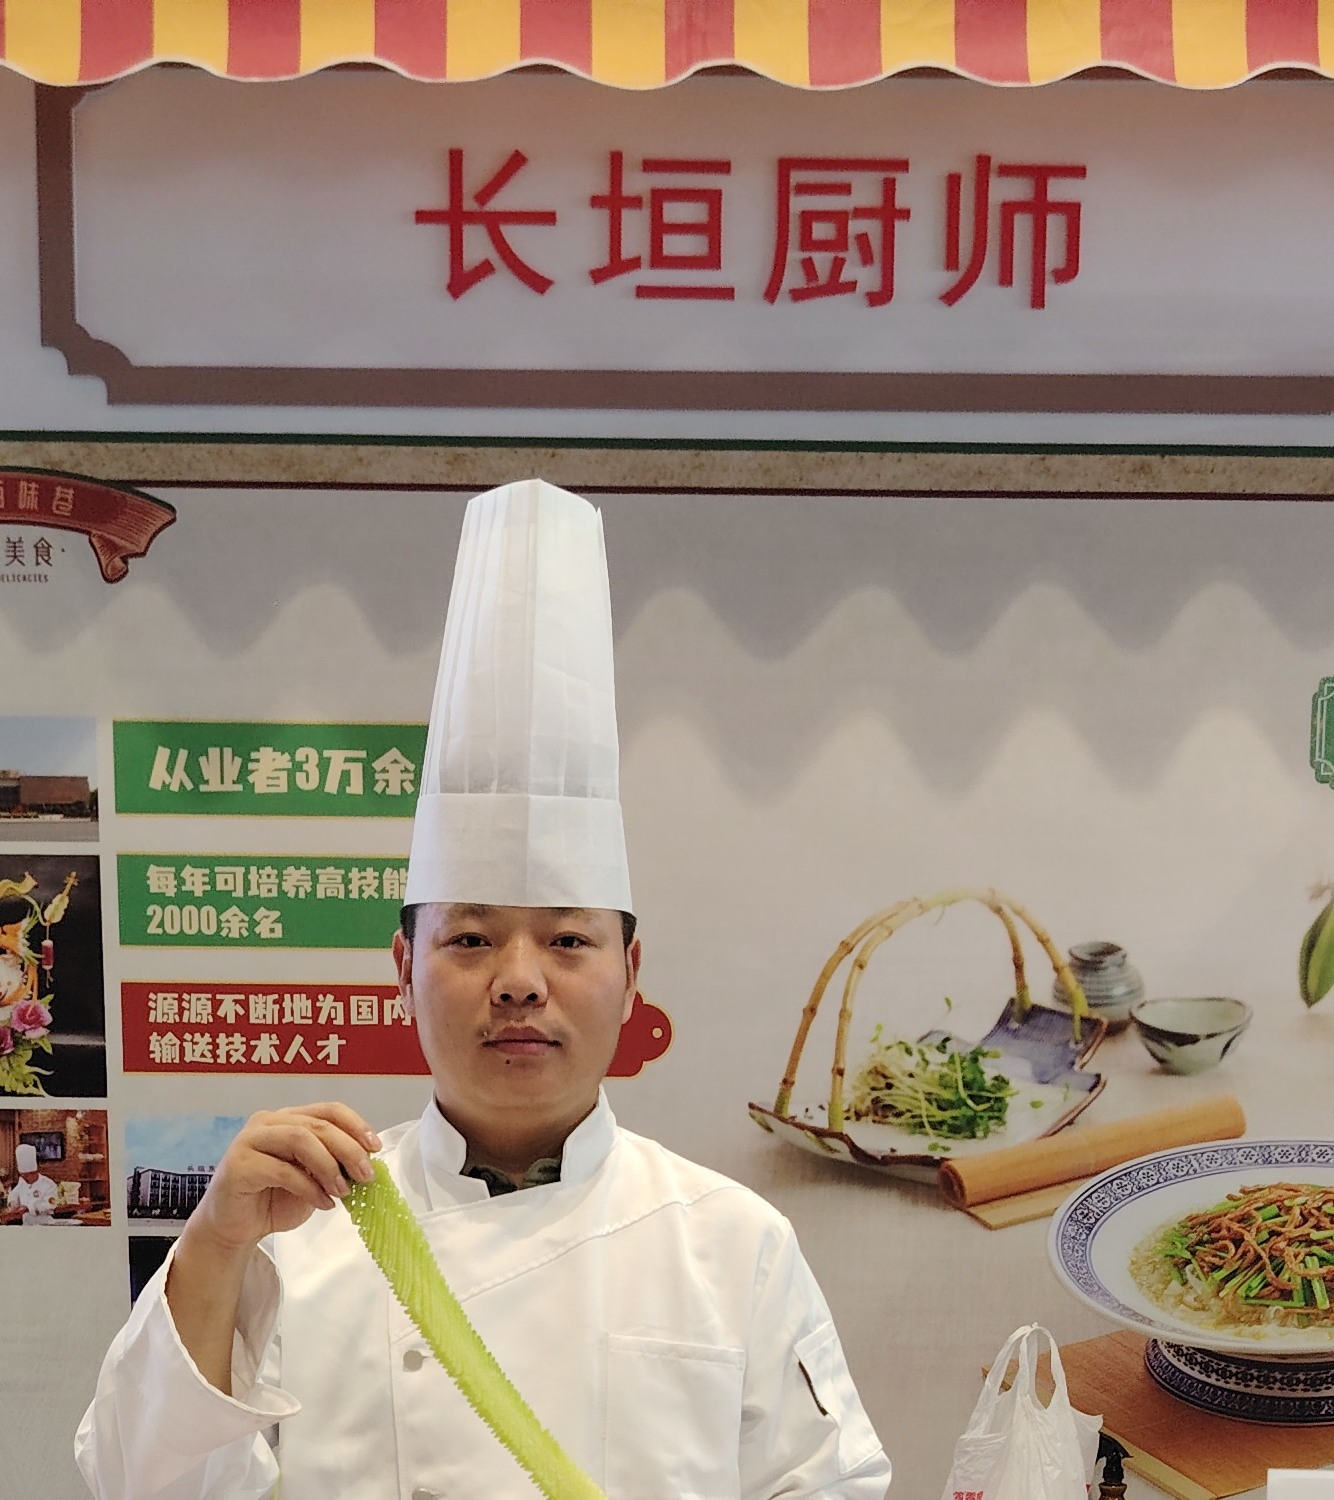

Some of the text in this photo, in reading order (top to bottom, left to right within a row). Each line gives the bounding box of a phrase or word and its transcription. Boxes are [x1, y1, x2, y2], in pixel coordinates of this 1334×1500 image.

[414, 147, 1088, 310] 长垣厨师
[147, 747, 417, 797] 从业者3万余
[146, 905, 284, 940] 2000余名
[147, 992, 412, 1027] 源源不断地为国内
[148, 1033, 347, 1067] 输送技术人才
